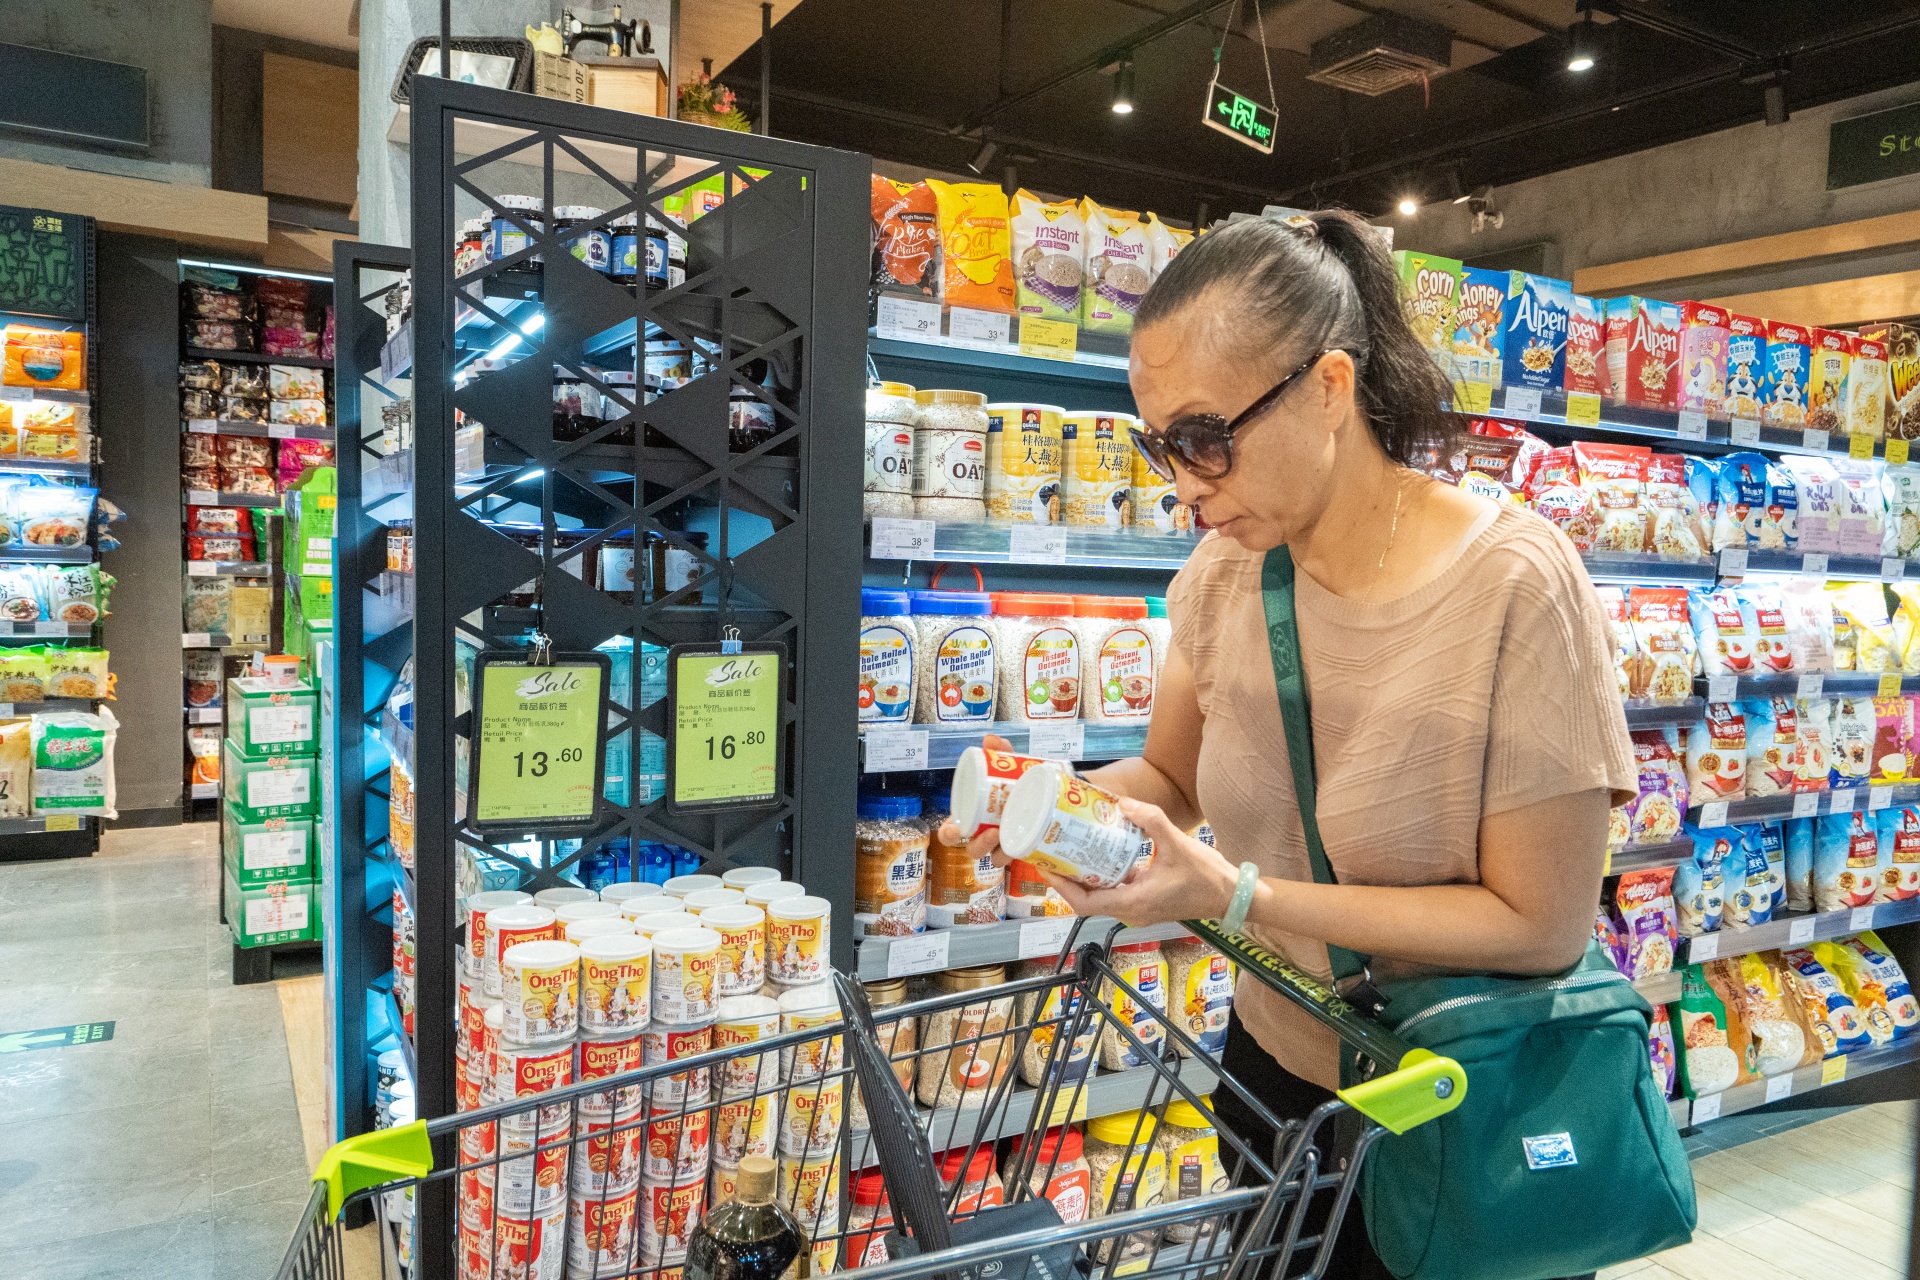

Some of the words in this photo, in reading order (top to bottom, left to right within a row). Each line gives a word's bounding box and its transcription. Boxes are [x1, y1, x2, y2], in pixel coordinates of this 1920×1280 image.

[574, 67, 585, 82] OF
[1035, 226, 1079, 244] Instant
[1104, 235, 1144, 255] Insant
[1417, 268, 1455, 298] Corn
[1459, 282, 1504, 314] Honey
[1508, 290, 1568, 338] Alpen
[917, 319, 928, 328] 29
[1607, 321, 1628, 332] Alpen
[988, 329, 998, 339] 33
[1630, 314, 1677, 356] Alpen
[1729, 344, 1755, 356] 香甜玉米片
[912, 537, 922, 547] 38
[1044, 543, 1054, 551] 42
[947, 639, 988, 648] SUMACO
[1034, 640, 1073, 648] SUMACO
[881, 647, 907, 658] Rolled
[941, 655, 968, 666] Whole
[970, 648, 991, 660] Rolled
[1042, 650, 1068, 662] Instant
[1113, 650, 1139, 661] Instant
[861, 658, 898, 672] Oatmeals
[949, 658, 984, 672] Oatmeals
[1038, 657, 1071, 671] Oatmeals
[1110, 657, 1141, 670] Oatmeals
[715, 660, 762, 683] Sale
[526, 671, 584, 695] Sale
[708, 689, 751, 698] 商品标价签
[519, 702, 568, 711] 商品标价签
[705, 735, 736, 761] 16
[741, 731, 765, 745] .80
[905, 748, 915, 756] 33
[1062, 742, 1071, 750] 33
[513, 752, 549, 778] 13
[555, 748, 583, 762] .60
[891, 861, 923, 880] 黑麦片
[1052, 933, 1061, 941] 35
[1212, 958, 1227, 969] 西麦
[589, 963, 644, 983] ÔngThọ
[1141, 968, 1157, 978] 西麦
[1055, 1193, 1083, 1212] 燕麦片
